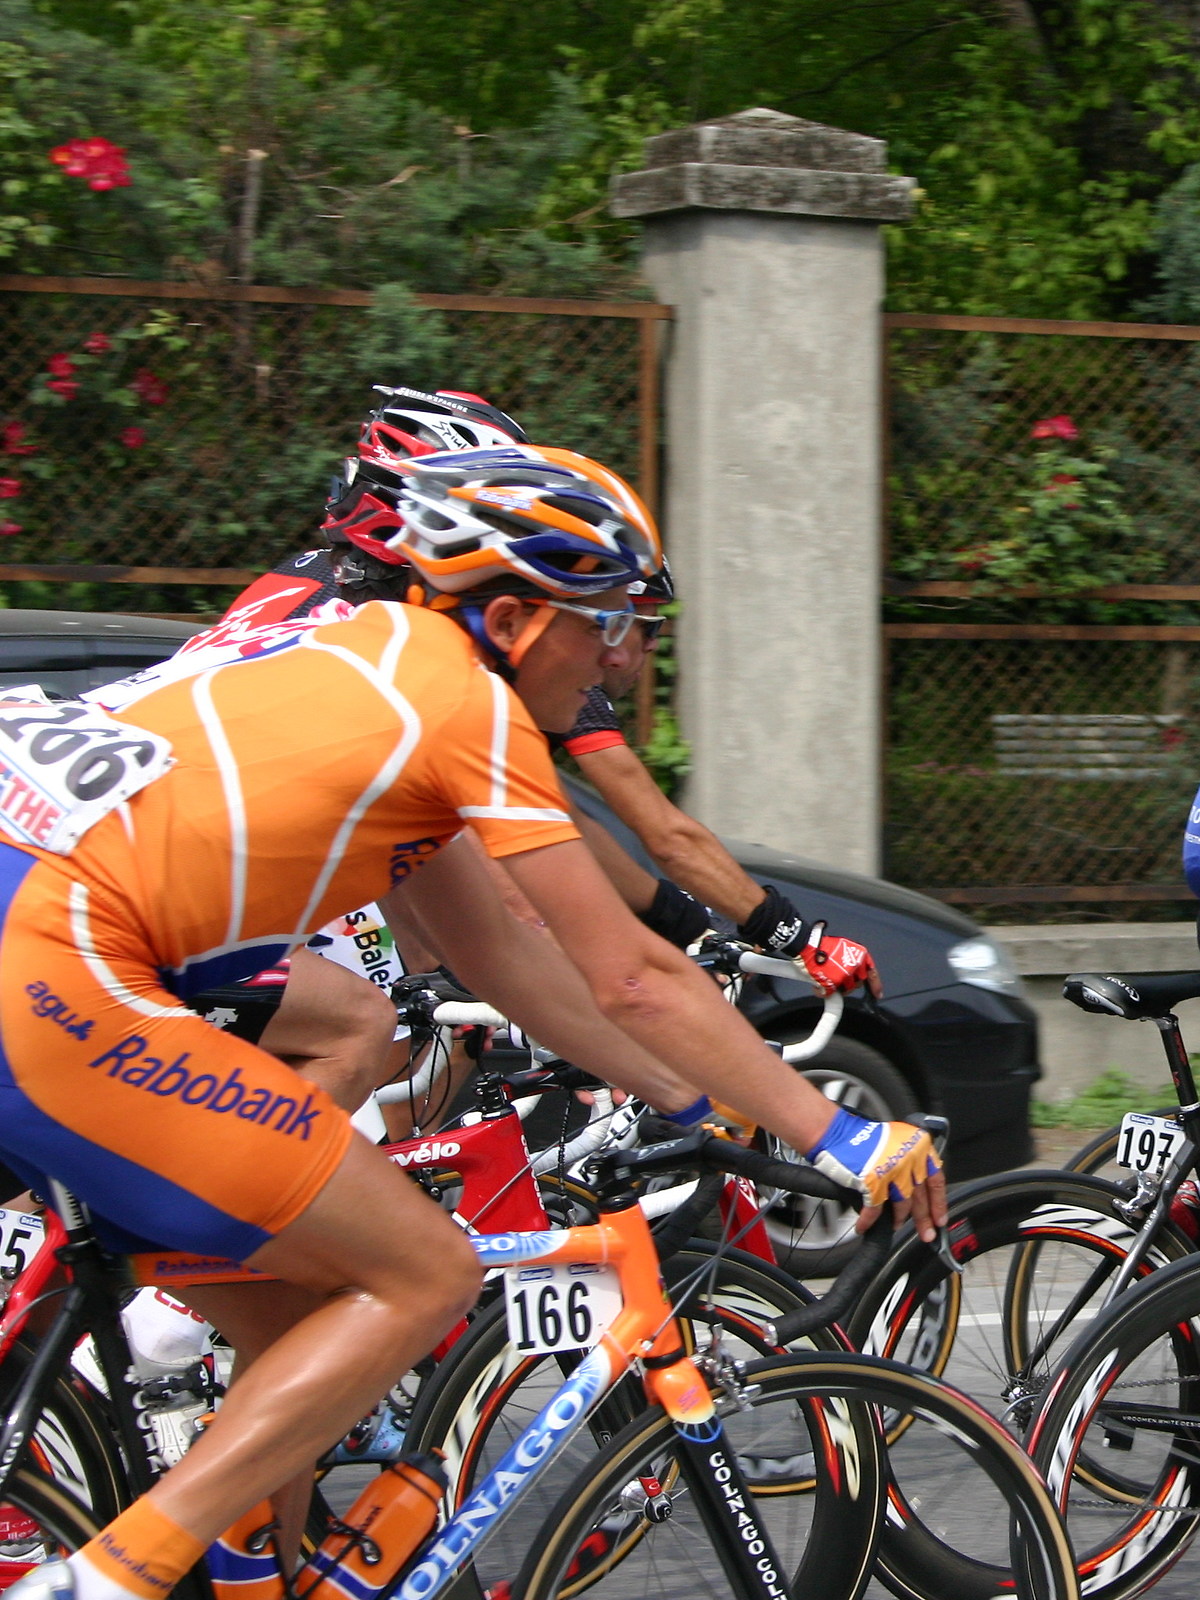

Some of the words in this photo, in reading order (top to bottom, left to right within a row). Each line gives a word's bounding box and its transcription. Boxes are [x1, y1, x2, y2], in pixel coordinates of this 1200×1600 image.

[1, 776, 61, 843] THE
[89, 1034, 322, 1141] Rabobank
[388, 1141, 461, 1167] vélo
[1119, 1127, 1175, 1175] 197
[513, 1281, 592, 1351] 166
[398, 1391, 584, 1600] OLNAGO
[708, 1451, 765, 1556] COLNAGO
